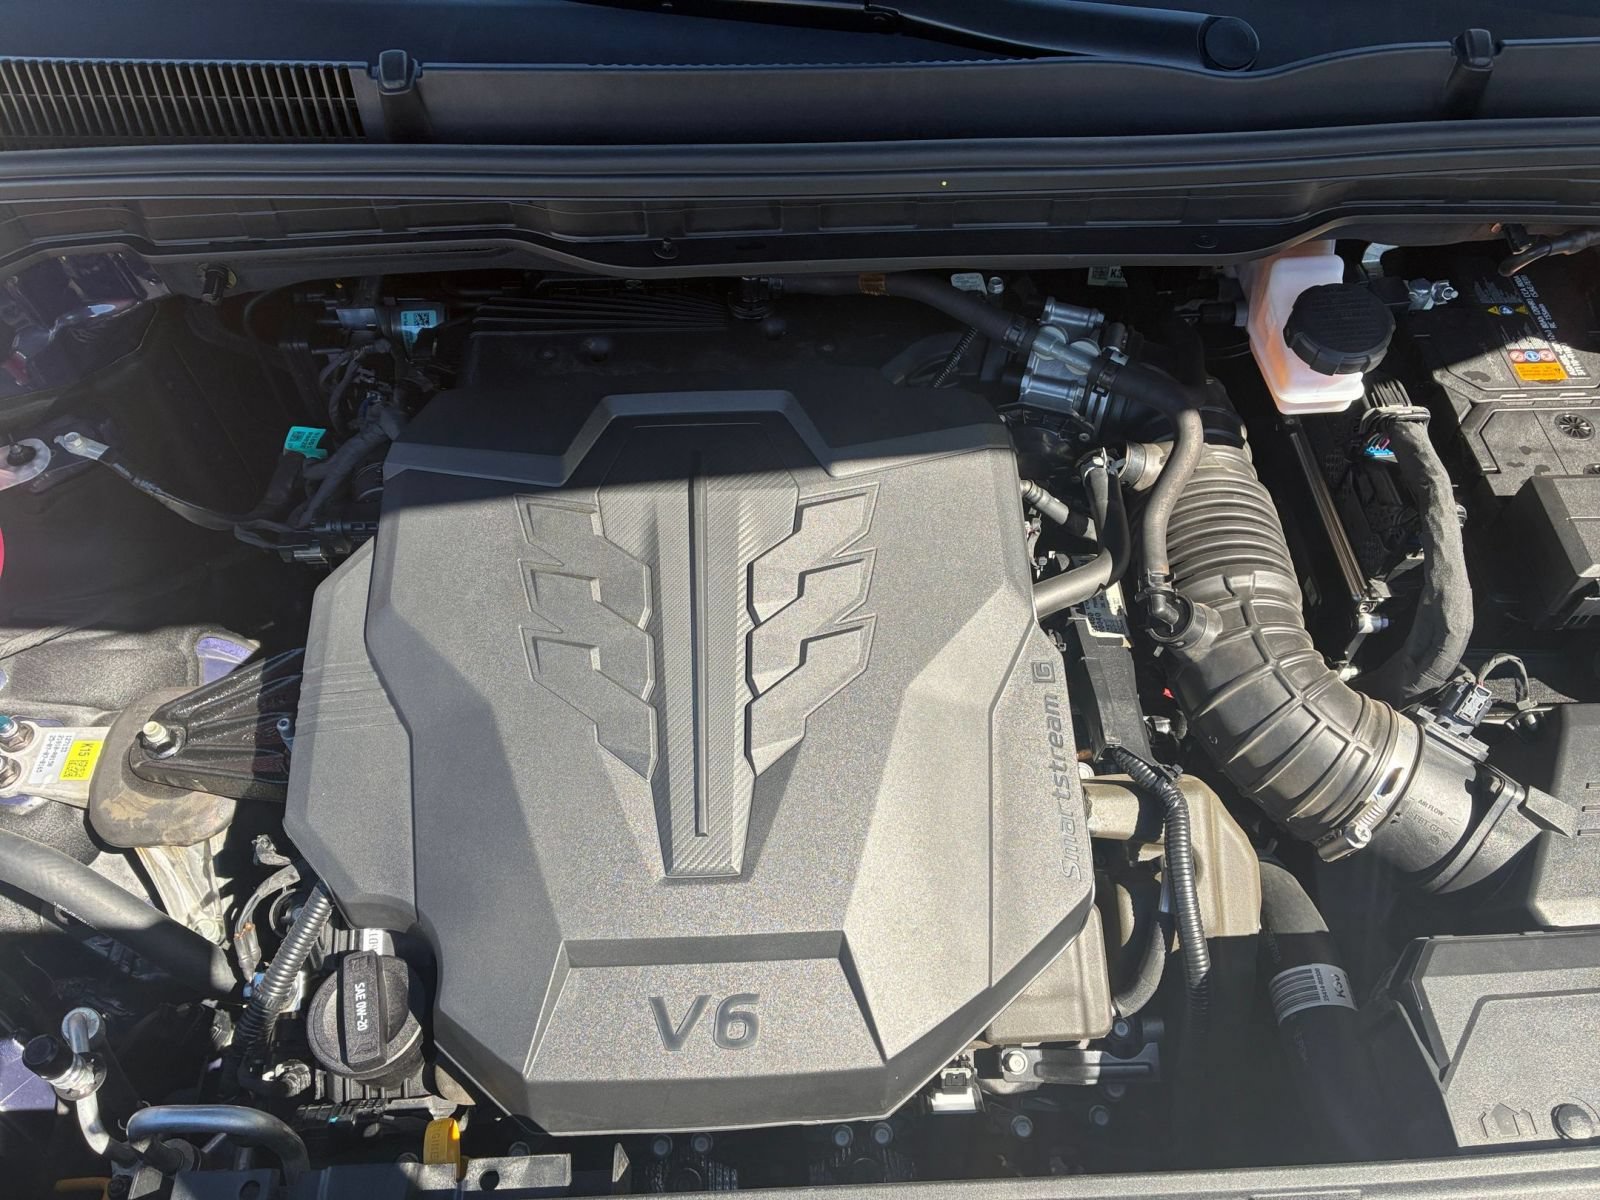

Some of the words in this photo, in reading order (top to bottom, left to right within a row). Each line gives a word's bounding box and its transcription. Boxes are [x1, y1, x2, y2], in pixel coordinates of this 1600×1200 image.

[78, 743, 94, 757] K15
[1044, 694, 1082, 881] Smartstream
[1427, 804, 1445, 816] FLOW
[355, 982, 366, 1001] SAE
[356, 1001, 368, 1031] 0W-20
[648, 993, 760, 1051] V6
